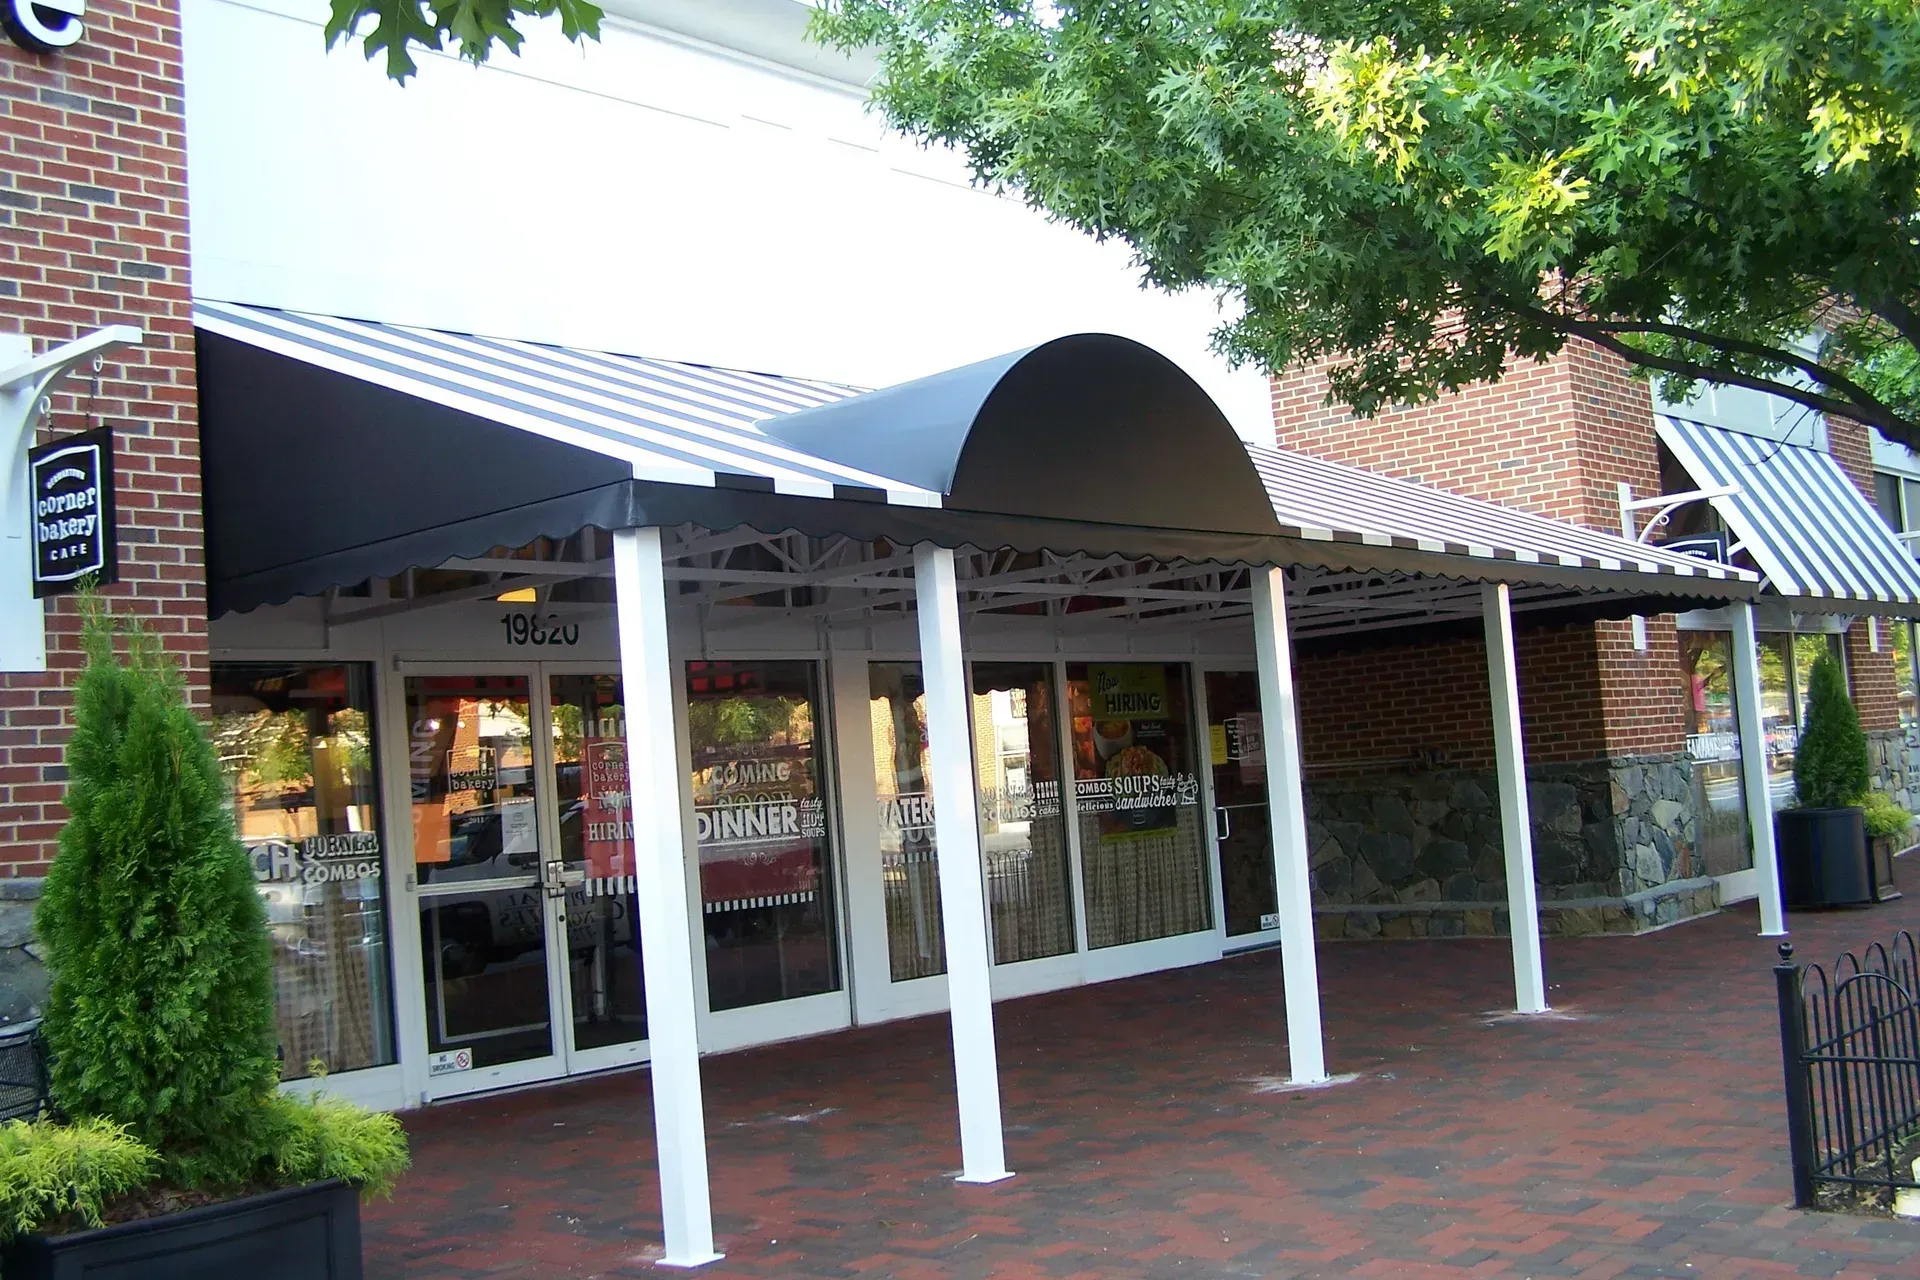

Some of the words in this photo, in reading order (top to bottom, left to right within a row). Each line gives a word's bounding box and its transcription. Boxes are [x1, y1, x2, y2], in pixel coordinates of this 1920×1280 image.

[38, 487, 96, 517] corner
[39, 514, 97, 542] bakery
[51, 543, 87, 561] CAFE
[501, 613, 579, 645] 19820
[1104, 693, 1161, 715] HIRING
[452, 779, 495, 790] bakery
[712, 761, 791, 787] COMING
[1114, 774, 1160, 795] SOUPS
[800, 796, 823, 812] tasty
[1115, 788, 1177, 811] sandwiches
[695, 805, 800, 841] DINNER
[801, 827, 826, 838] SOUPS
[304, 832, 379, 857] CORNER
[304, 861, 381, 883] COMBOS
